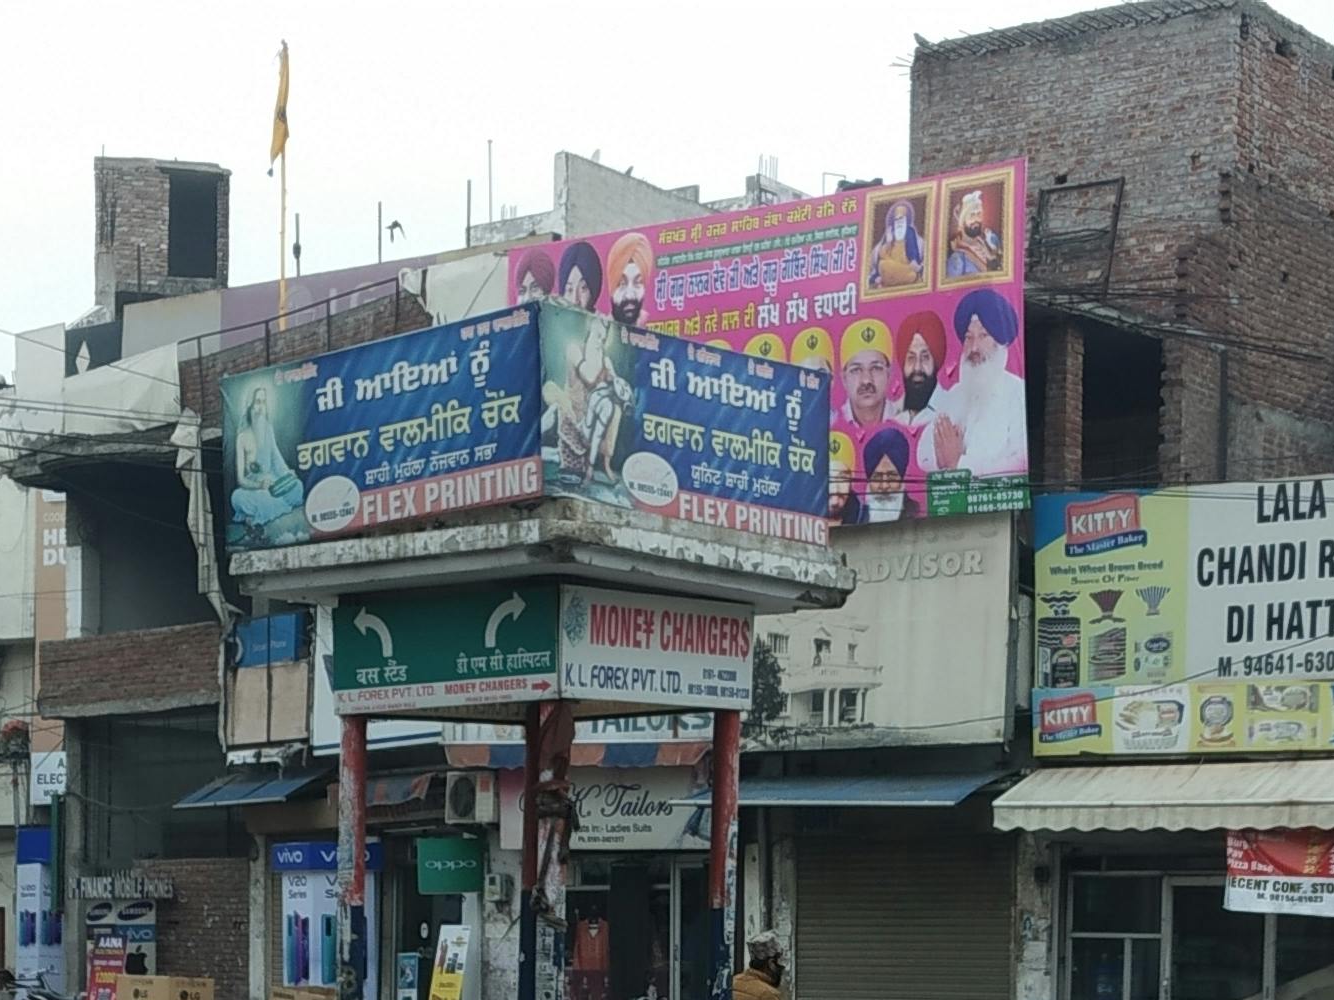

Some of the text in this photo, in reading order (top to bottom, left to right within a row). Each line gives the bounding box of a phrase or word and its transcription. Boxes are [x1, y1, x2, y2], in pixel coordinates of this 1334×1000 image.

[814, 283, 857, 319] ਵਧਾਈ
[316, 377, 344, 412] ਜੀ
[355, 352, 458, 401] ਆਇਆਂ
[469, 340, 490, 388] ਨੂੰ
[649, 358, 677, 392] ਜੀ
[686, 372, 777, 413] ਆਇਆਂ
[785, 389, 802, 431] ਨੂੰ
[297, 430, 370, 471] ਭਗਵਾਨ
[379, 400, 472, 452] ਵਾਲਮੀਕਿ
[643, 413, 705, 452] ਭਗਵਾਨ
[711, 428, 782, 469] ਵਾਲਮੀਕਿ
[474, 443, 497, 462] ਸਭਾ
[362, 462, 538, 526] FLEX PRINTING
[1257, 480, 1327, 524] LALA
[679, 493, 730, 528] FLEX
[735, 506, 827, 546] PRINTING
[1072, 509, 1131, 535] KITTY
[1069, 534, 1143, 554] The Master Baker
[1197, 541, 1307, 588] CHANDI
[1227, 604, 1254, 643] DI
[456, 652, 468, 674] डी
[470, 656, 487, 675] एम
[489, 649, 504, 671] सी
[1218, 656, 1238, 678] M.
[591, 665, 629, 690] FOREX
[632, 669, 657, 692] PVT.
[660, 669, 682, 694] LTD.
[357, 689, 389, 701] FOREX
[1044, 705, 1091, 725] KITTY
[600, 783, 673, 817] Tailors
[632, 823, 652, 832] Suits
[277, 848, 304, 864] vivo
[425, 859, 476, 870] oppo
[80, 877, 174, 899] FINANCE MOBILE PHONES
[288, 889, 307, 899] Series
